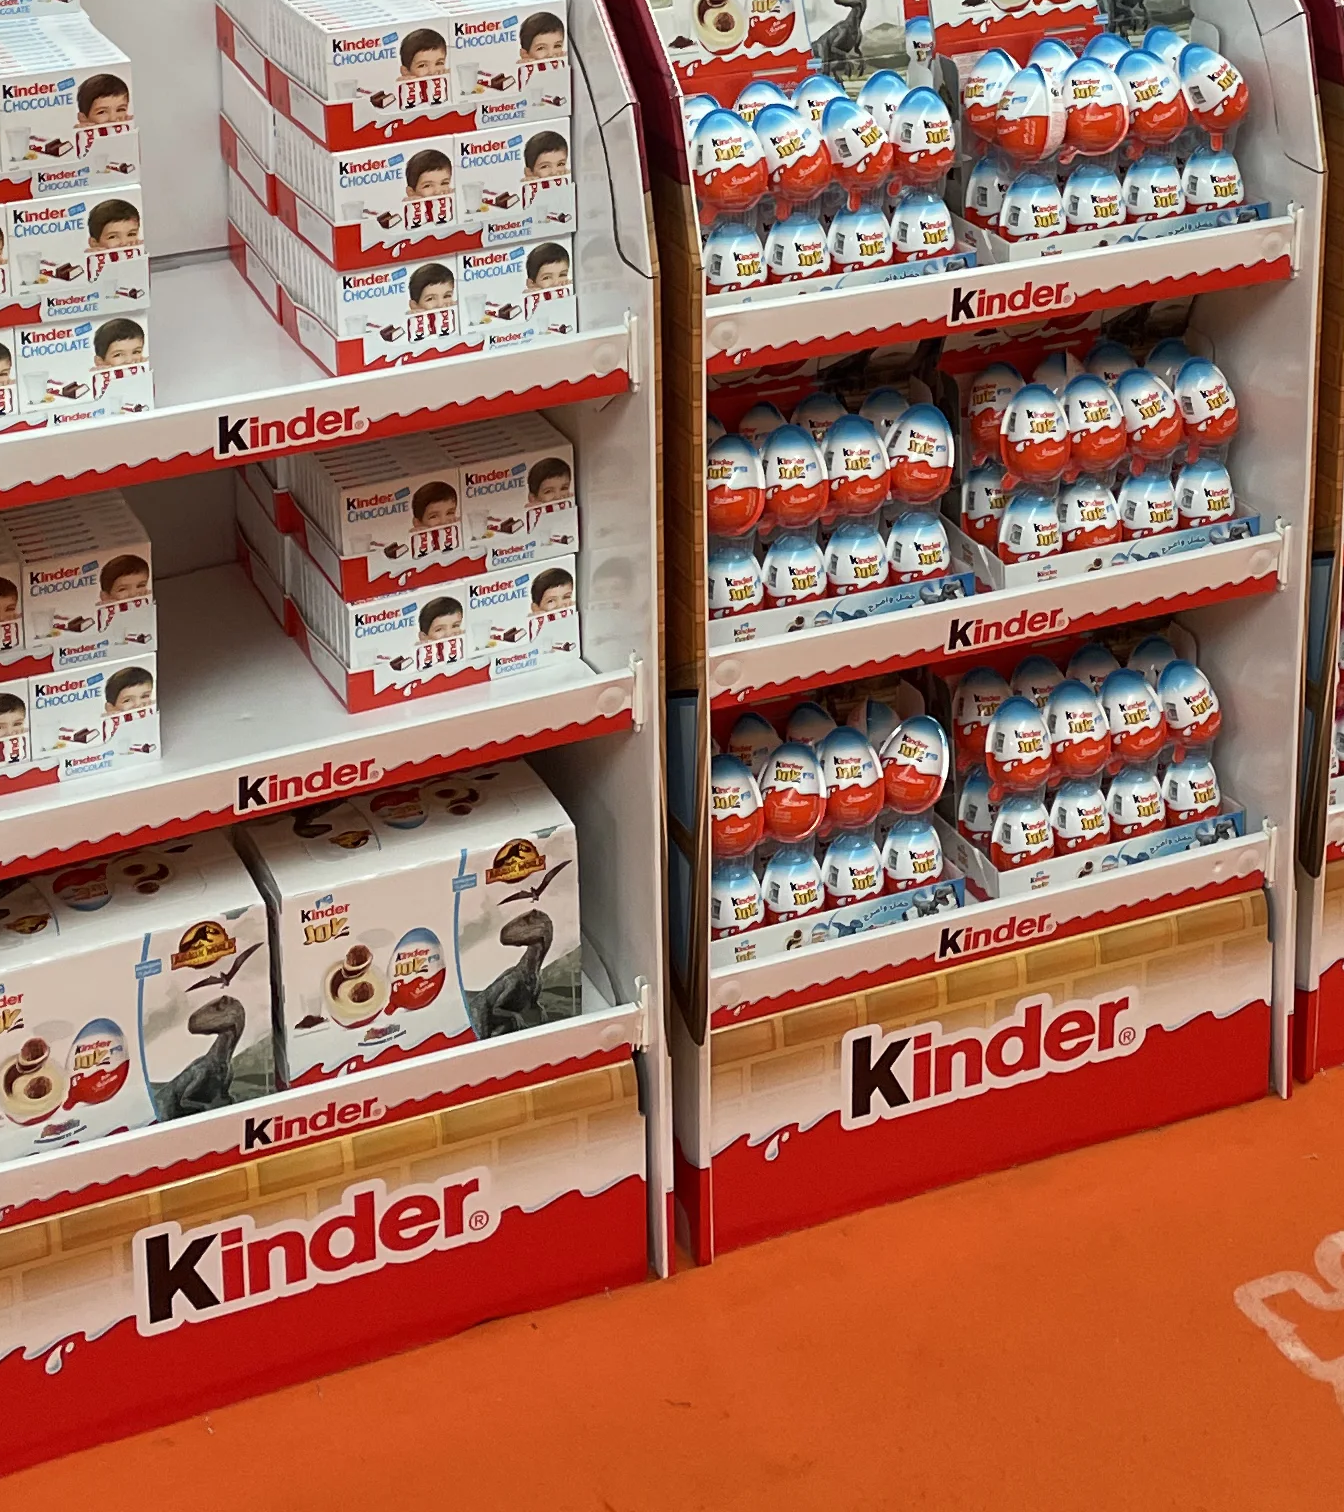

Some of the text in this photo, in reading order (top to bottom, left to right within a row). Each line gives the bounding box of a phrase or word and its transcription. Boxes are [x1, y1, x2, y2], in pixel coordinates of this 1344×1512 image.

[455, 20, 501, 36] Kinder
[333, 37, 381, 53] Kinder
[456, 31, 516, 49] CHOCOLATE
[334, 49, 397, 66] CHOCOLATE
[2, 83, 57, 99] Kinder
[4, 94, 73, 113] CHOCOLATE
[461, 139, 507, 156] Kinder
[340, 158, 388, 175] Kinder
[462, 150, 521, 168] CHOCOLATE
[340, 168, 402, 187] CHOCOLATE
[13, 207, 67, 224] Kinder
[14, 218, 84, 237] CHOCOLATE
[951, 281, 1070, 322] Kinder
[21, 328, 74, 345] Kinder
[22, 339, 89, 358] CHOCOLATE
[218, 405, 360, 454] Kinder
[355, 609, 401, 627] Kinder
[355, 618, 415, 638] CHOCOLATE
[948, 607, 1063, 650] Kinder
[35, 678, 86, 697] Kinder
[36, 688, 102, 709] CHOCOLATE
[238, 758, 376, 810] Kinder
[301, 903, 350, 923] Kinder
[303, 917, 349, 945] JOY
[939, 912, 1050, 959] Kinder
[851, 996, 1129, 1119] Kinder
[244, 1095, 379, 1149] Kinder
[146, 1178, 479, 1324] Kinder
